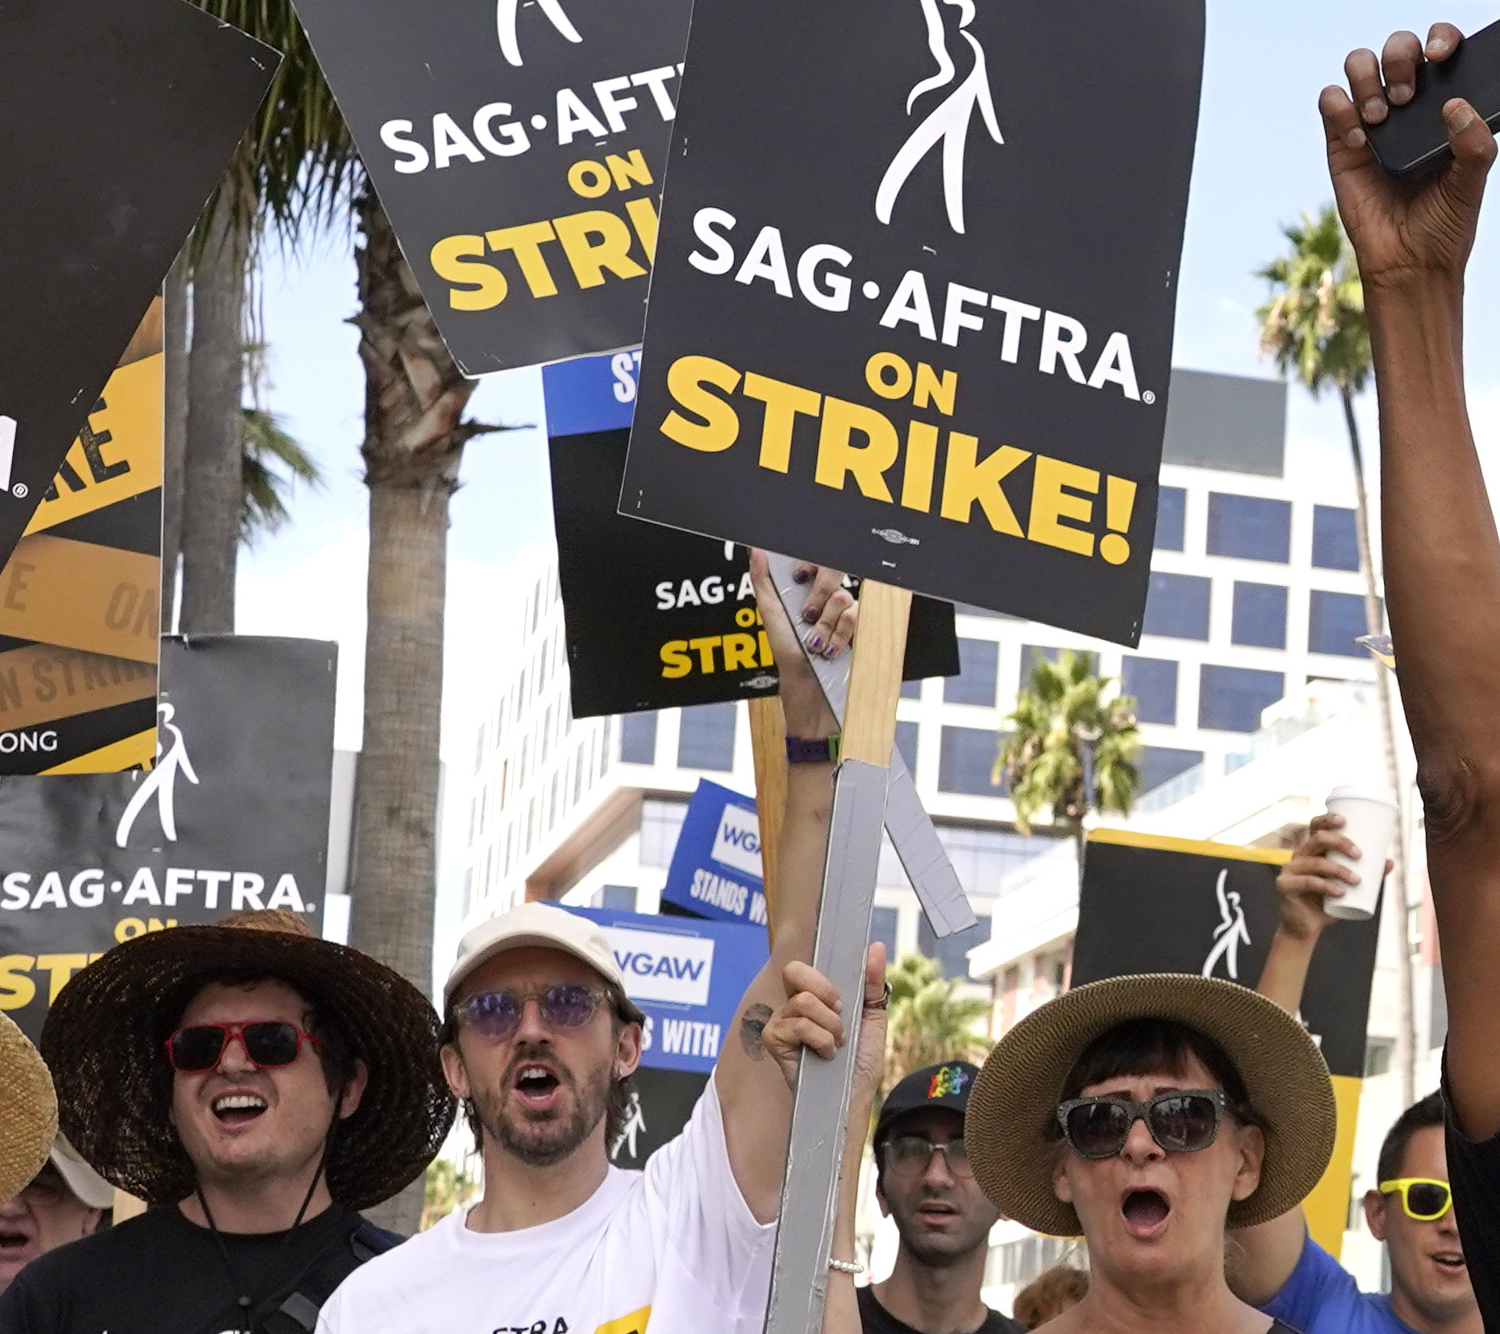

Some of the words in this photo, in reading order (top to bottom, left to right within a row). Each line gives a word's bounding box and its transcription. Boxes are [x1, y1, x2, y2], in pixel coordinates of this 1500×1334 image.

[379, 63, 685, 174] SAG·AFT
[567, 149, 654, 198] ON
[430, 194, 662, 312] STRI
[688, 206, 1141, 403] SAG·AFTRA
[865, 352, 958, 416] ON
[659, 355, 1138, 566] STRIKE!
[659, 633, 776, 679] STRI
[690, 868, 749, 916] STANDS
[662, 1018, 721, 1058] WITH
